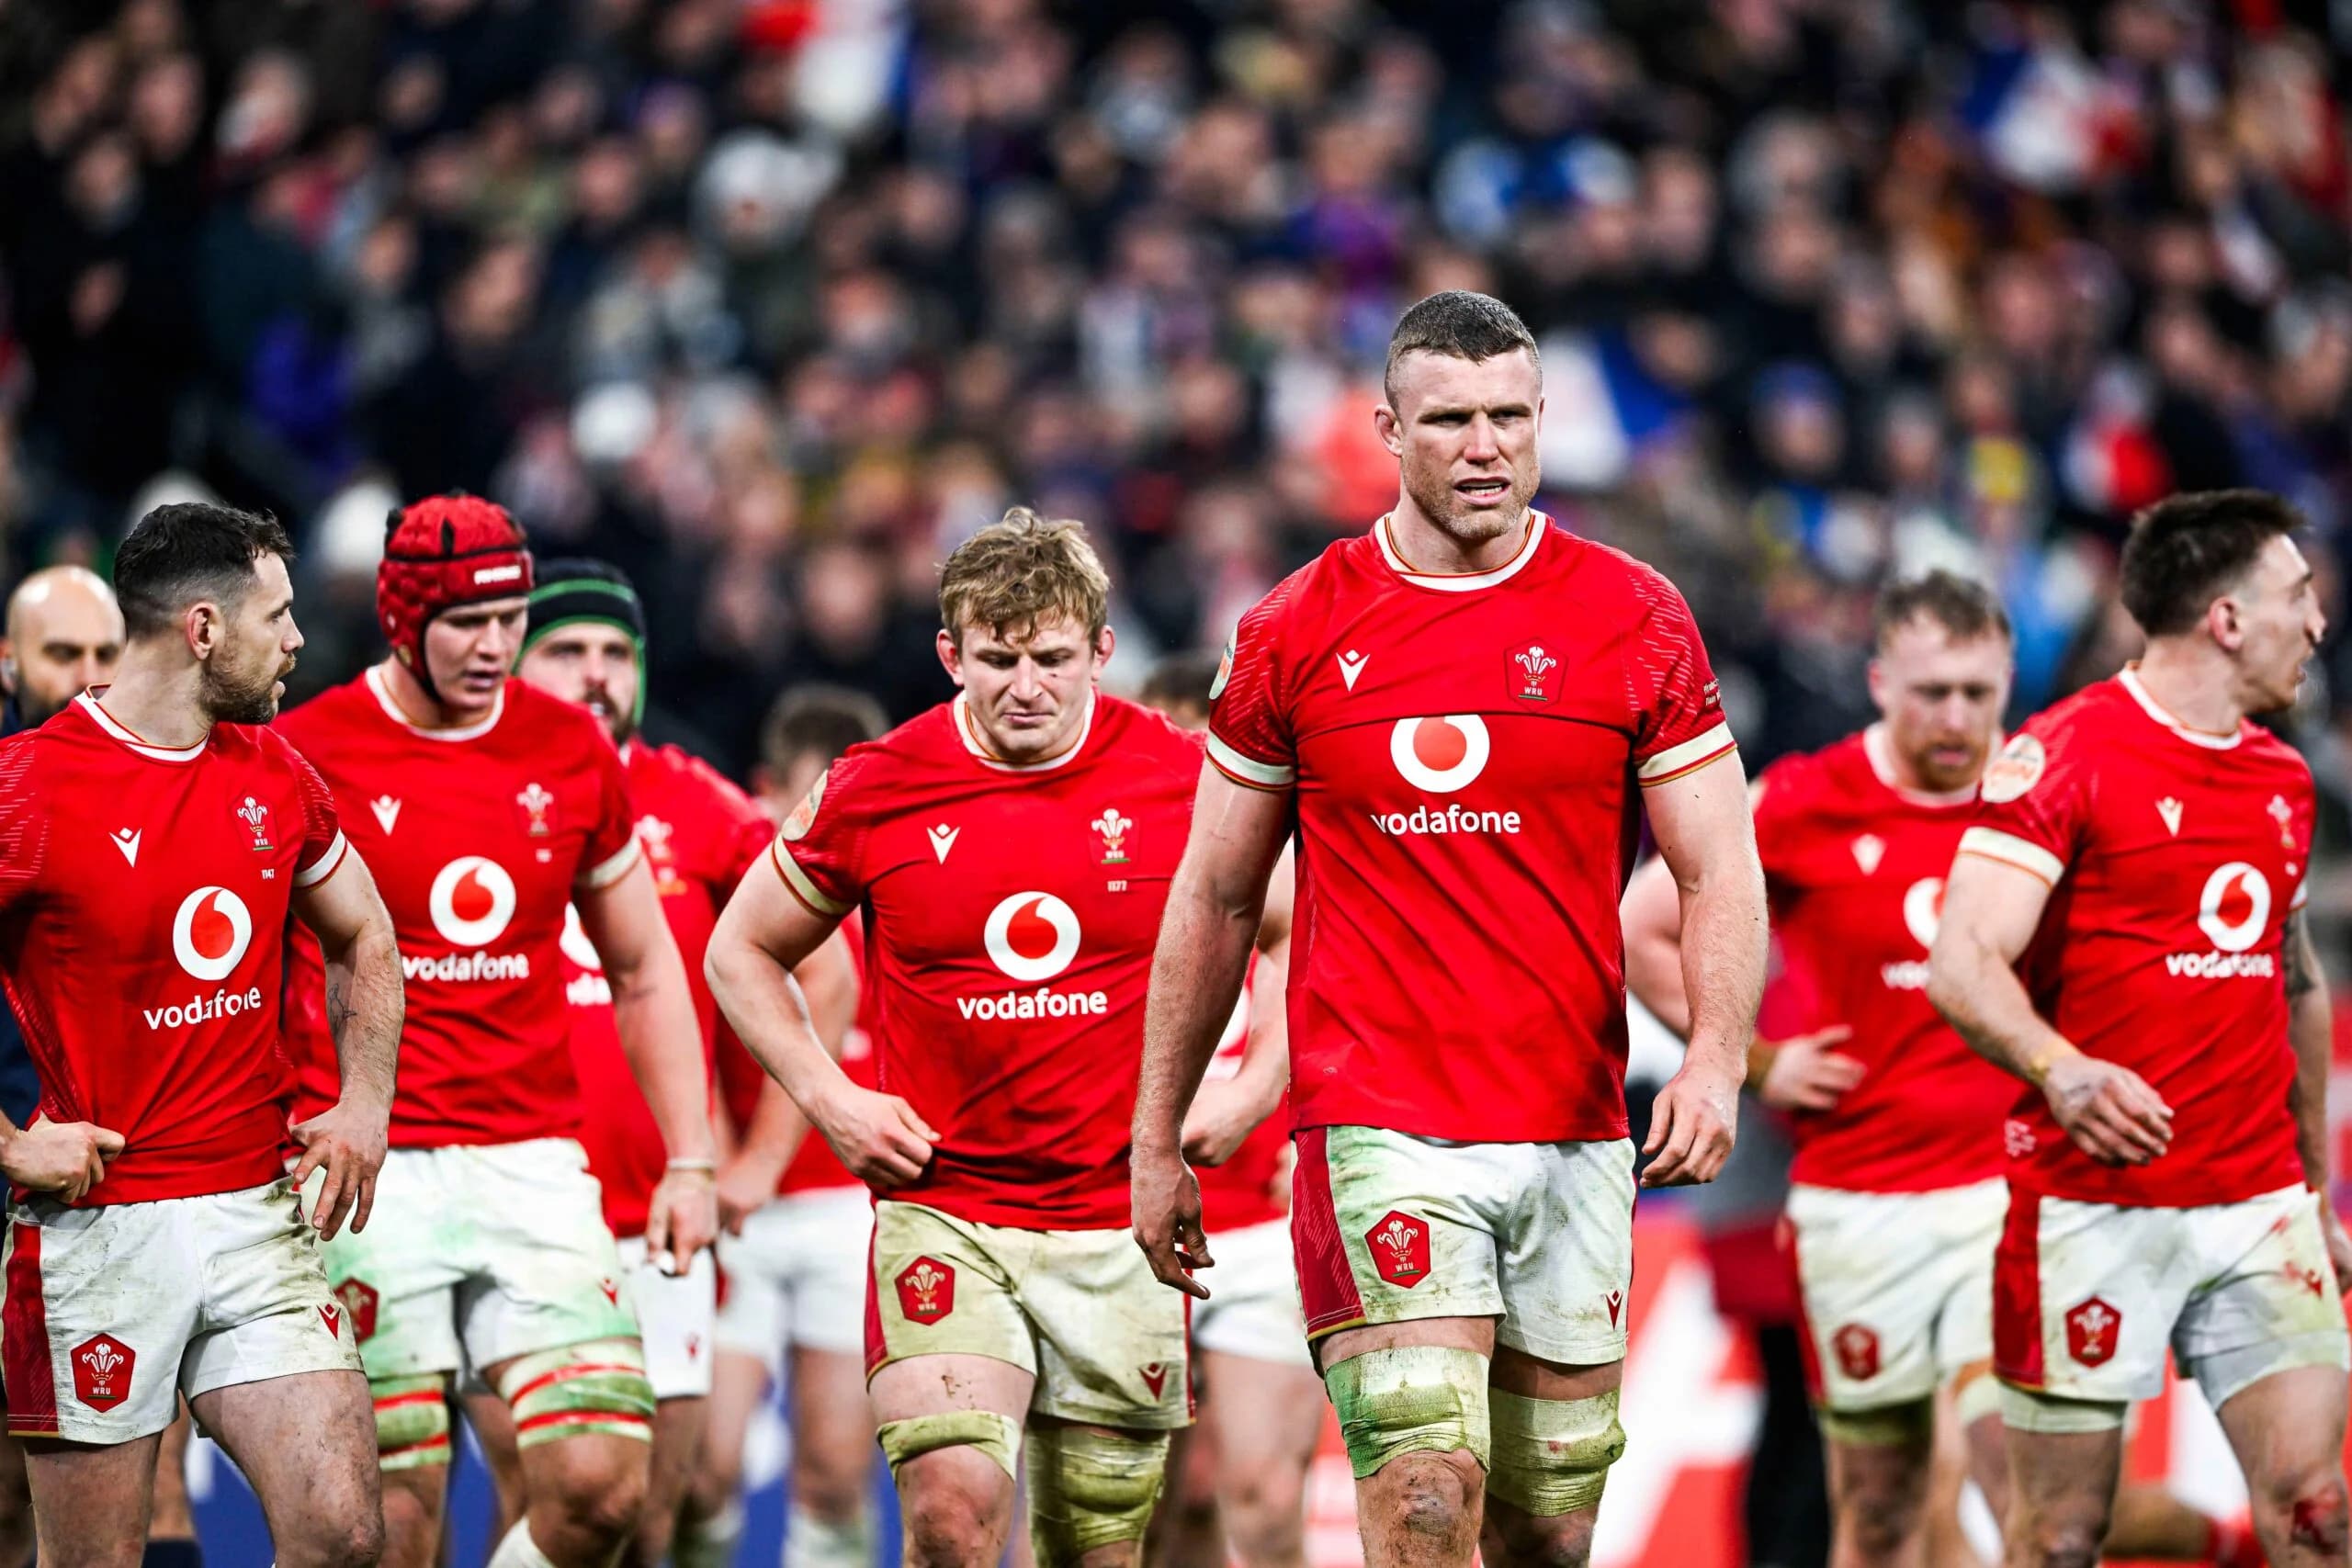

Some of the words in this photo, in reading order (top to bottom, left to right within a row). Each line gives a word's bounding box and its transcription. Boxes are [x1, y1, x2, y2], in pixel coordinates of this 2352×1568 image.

[1524, 686, 1543, 695] WRU
[1370, 803, 1521, 835] vodafone
[401, 951, 530, 981] vodafone
[956, 987, 1108, 1021] vodafone
[92, 1386, 111, 1395] WRU
